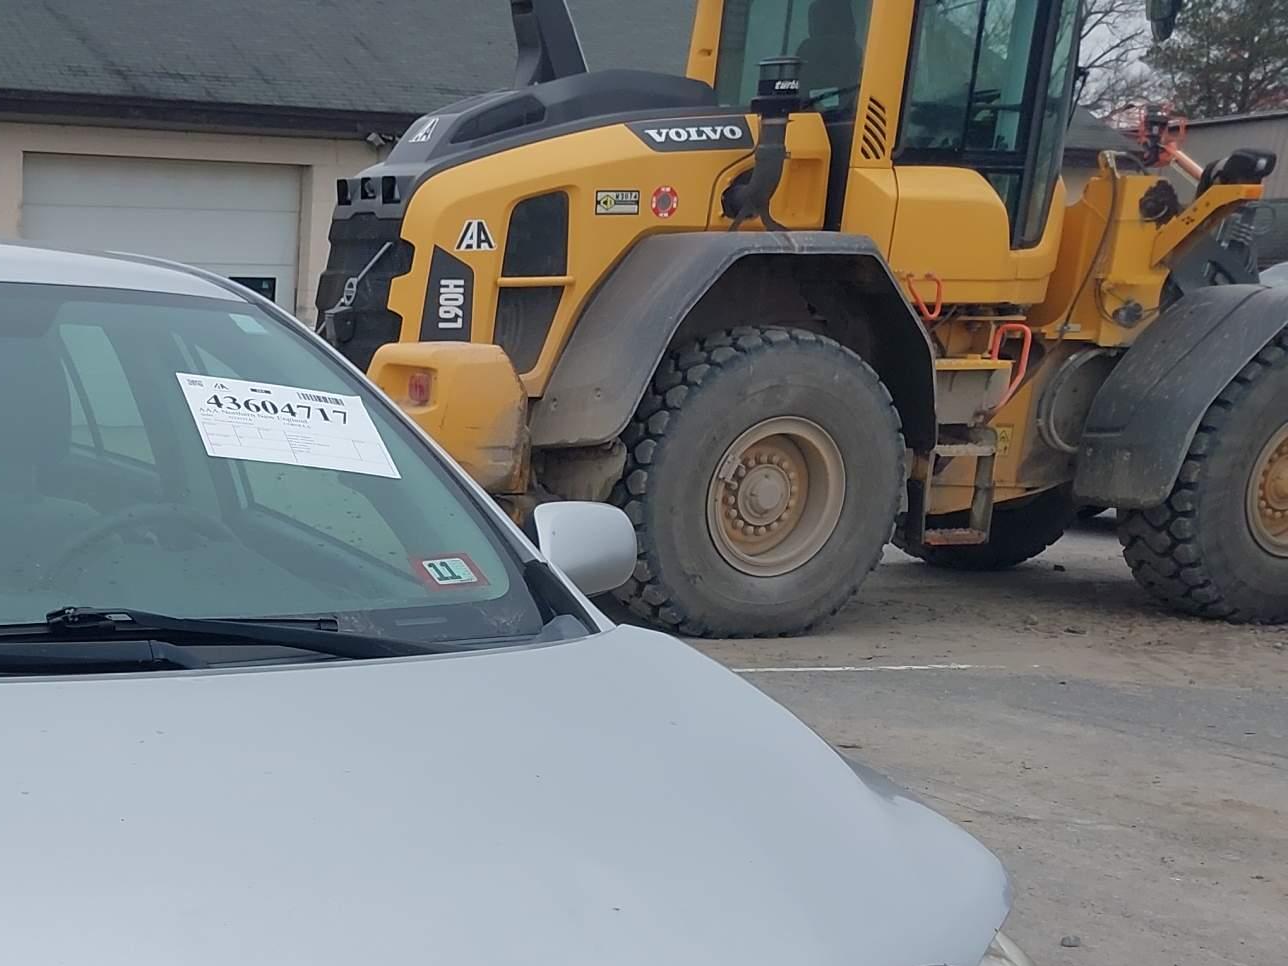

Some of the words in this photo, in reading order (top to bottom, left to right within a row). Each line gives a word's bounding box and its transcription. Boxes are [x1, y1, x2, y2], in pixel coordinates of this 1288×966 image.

[644, 126, 743, 142] VOLVO
[438, 279, 464, 329] L90H
[207, 394, 347, 425] 43604717
[428, 561, 462, 581] 11
